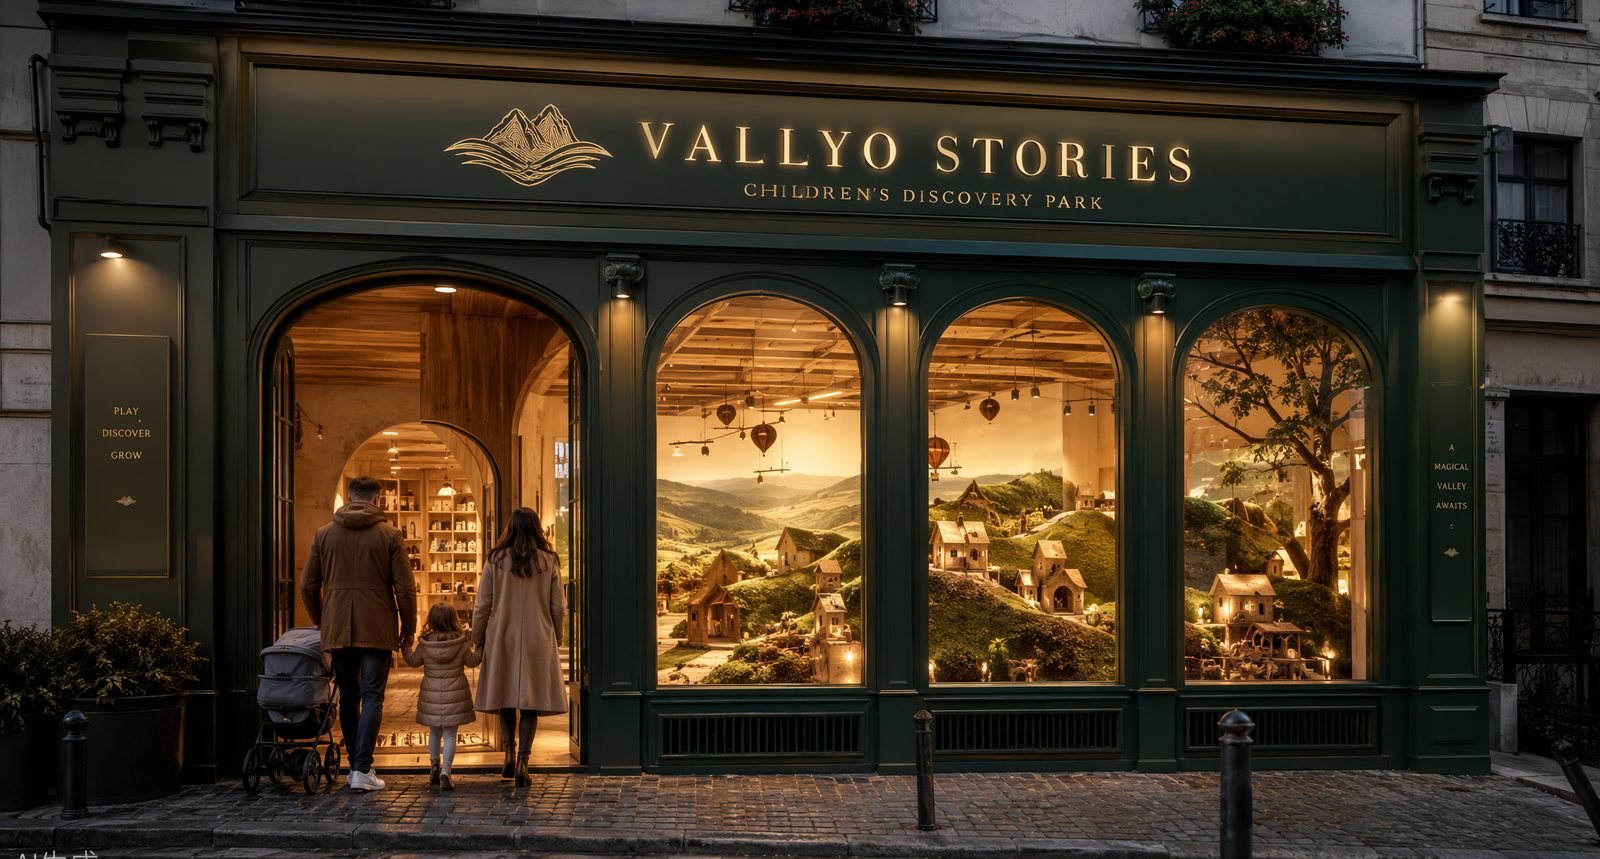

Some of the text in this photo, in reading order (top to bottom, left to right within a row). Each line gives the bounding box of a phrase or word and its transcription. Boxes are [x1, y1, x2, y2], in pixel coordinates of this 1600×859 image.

[638, 121, 1192, 184] VALLYO STORIES
[743, 183, 1104, 210] CHILDREN'S DISCOVERY PARK
[114, 407, 139, 416] PLAY
[102, 429, 151, 438] DISCOVER
[1448, 444, 1455, 452] A
[111, 451, 143, 460] GROW
[1434, 463, 1469, 471] MAGICAL
[1437, 482, 1467, 490] VALLEY
[1436, 502, 1468, 510] AWAITS
